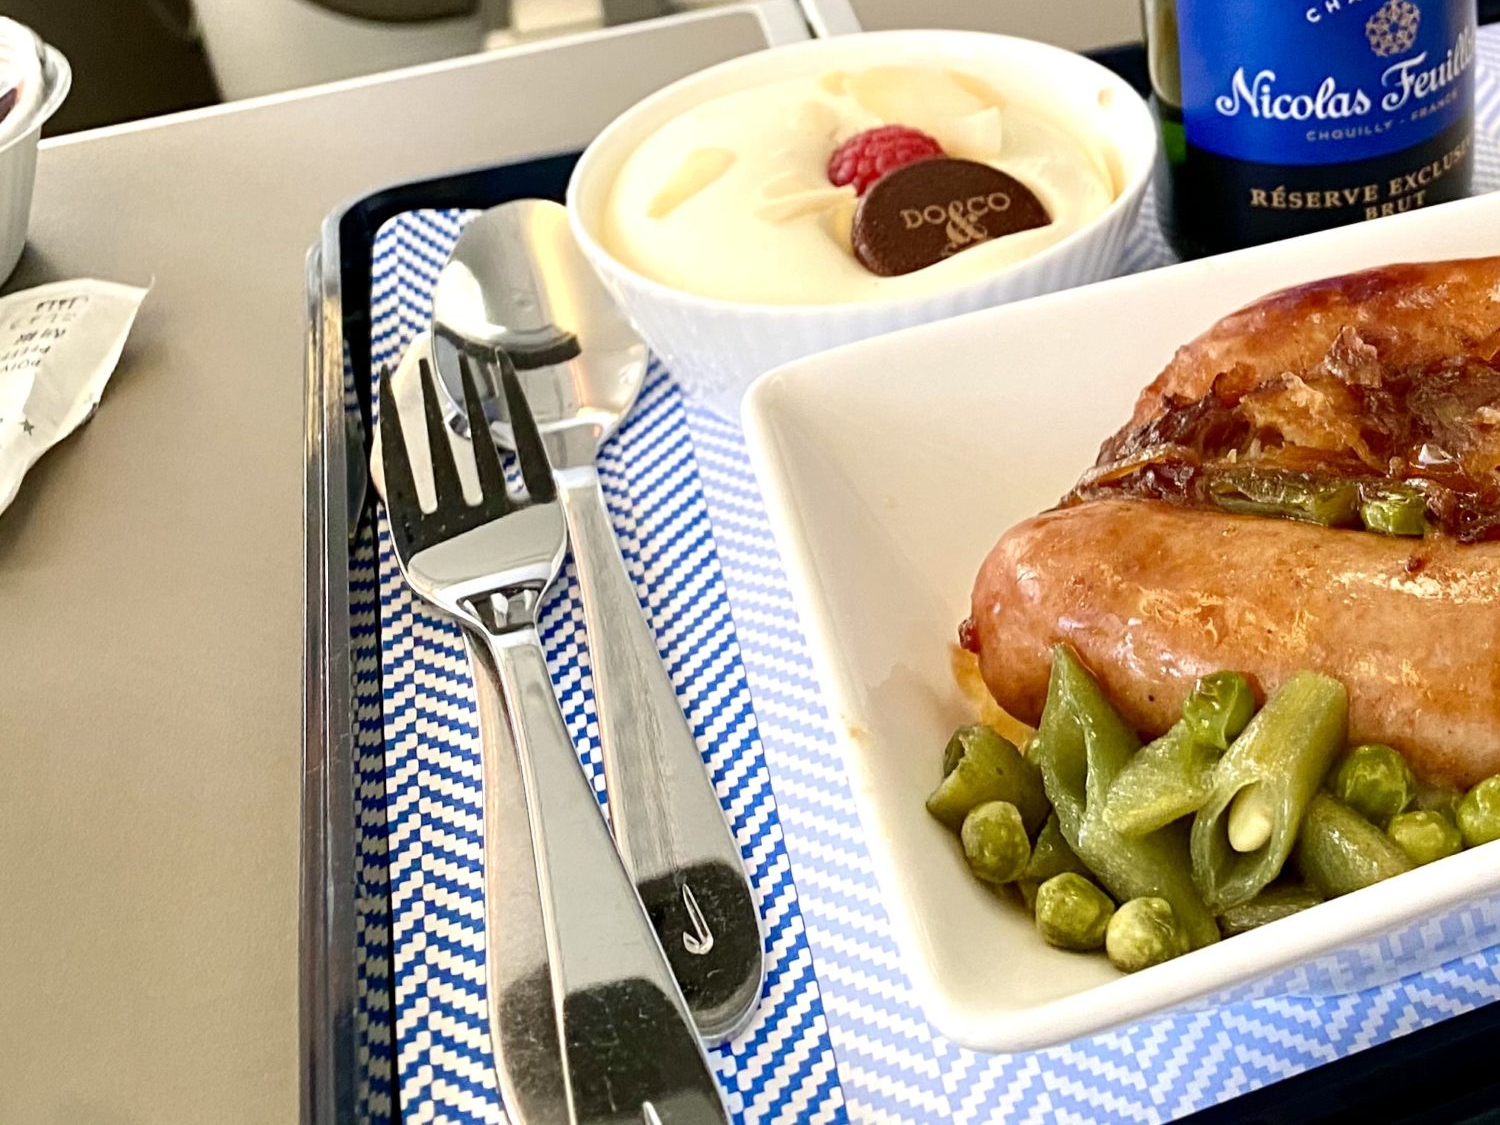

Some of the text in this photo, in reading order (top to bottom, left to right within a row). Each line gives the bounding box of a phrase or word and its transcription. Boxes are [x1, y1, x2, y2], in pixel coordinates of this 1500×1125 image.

[1215, 67, 1371, 120] Nicolas
[1306, 120, 1393, 142] CHOUILLY
[1250, 183, 1379, 209] RÉSERVE
[1365, 190, 1426, 220] BRUT
